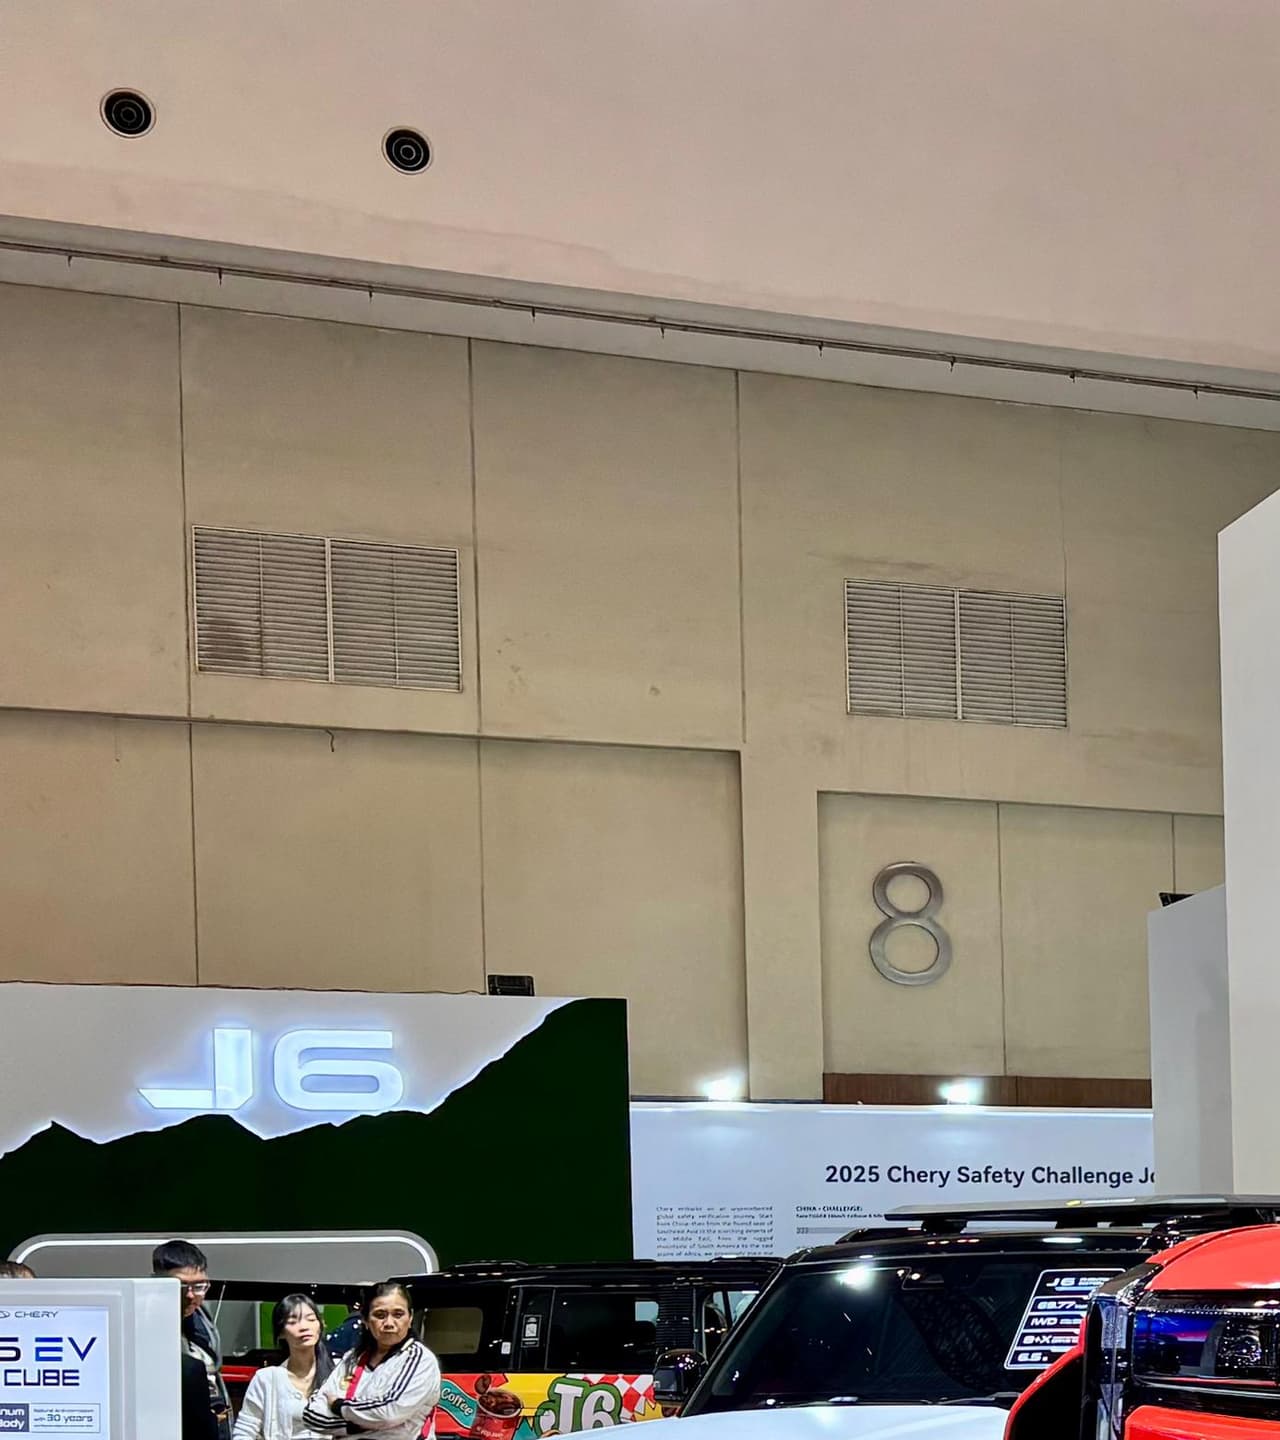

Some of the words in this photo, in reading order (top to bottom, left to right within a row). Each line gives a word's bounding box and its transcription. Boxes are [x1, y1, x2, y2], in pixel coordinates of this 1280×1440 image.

[869, 861, 952, 985] 8
[137, 1028, 404, 1111] J6
[825, 1165, 880, 1183] 2025
[887, 1165, 950, 1187] Chery
[957, 1166, 1025, 1188] Safety
[1031, 1166, 1133, 1188] Challenge
[35, 1337, 97, 1362] EV
[4, 1369, 80, 1386] CUBE
[441, 1387, 474, 1416] Coffee
[63, 1415, 93, 1424] years
